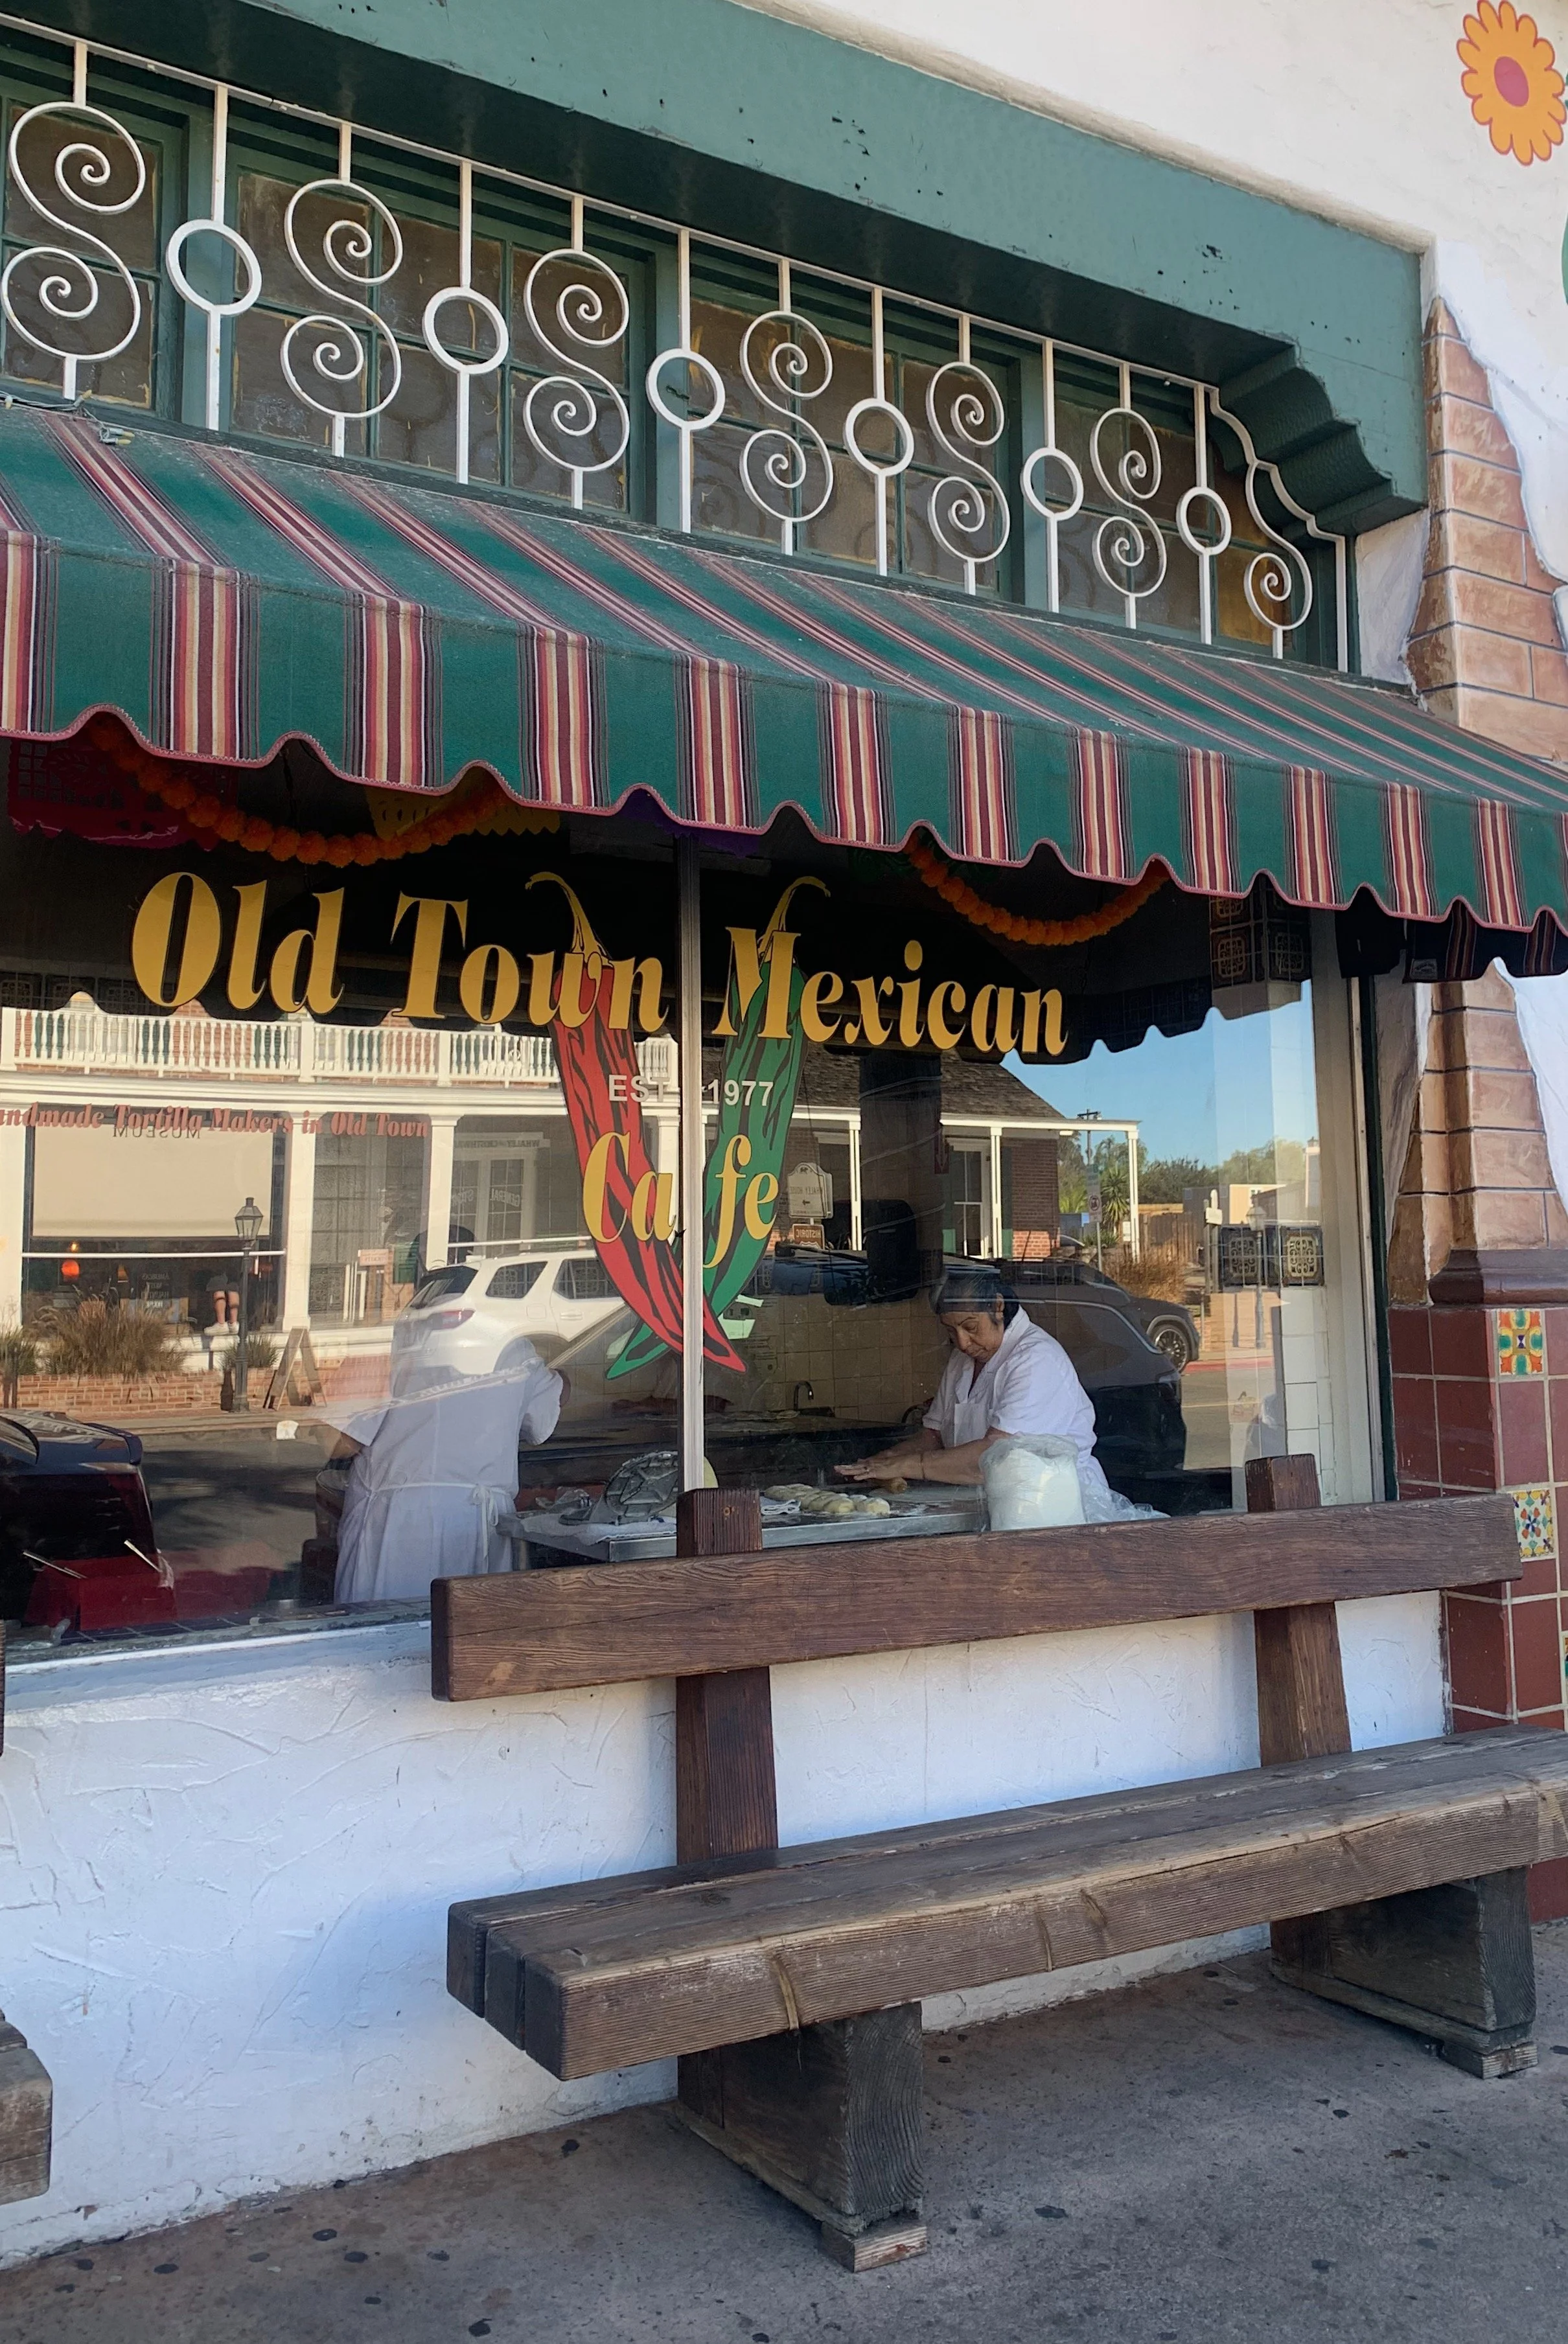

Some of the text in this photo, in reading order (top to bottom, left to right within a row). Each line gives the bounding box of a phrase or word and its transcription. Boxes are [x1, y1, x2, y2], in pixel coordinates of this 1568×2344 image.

[132, 872, 1068, 1056] Old Town Mexican
[113, 1104, 202, 1131] Tortilla
[209, 1108, 294, 1132] Makers
[301, 1110, 323, 1134] in
[330, 1112, 367, 1135] Old
[376, 1112, 428, 1136] Town
[608, 1075, 774, 1106] EST 1977
[583, 1132, 778, 1268] Cafe
